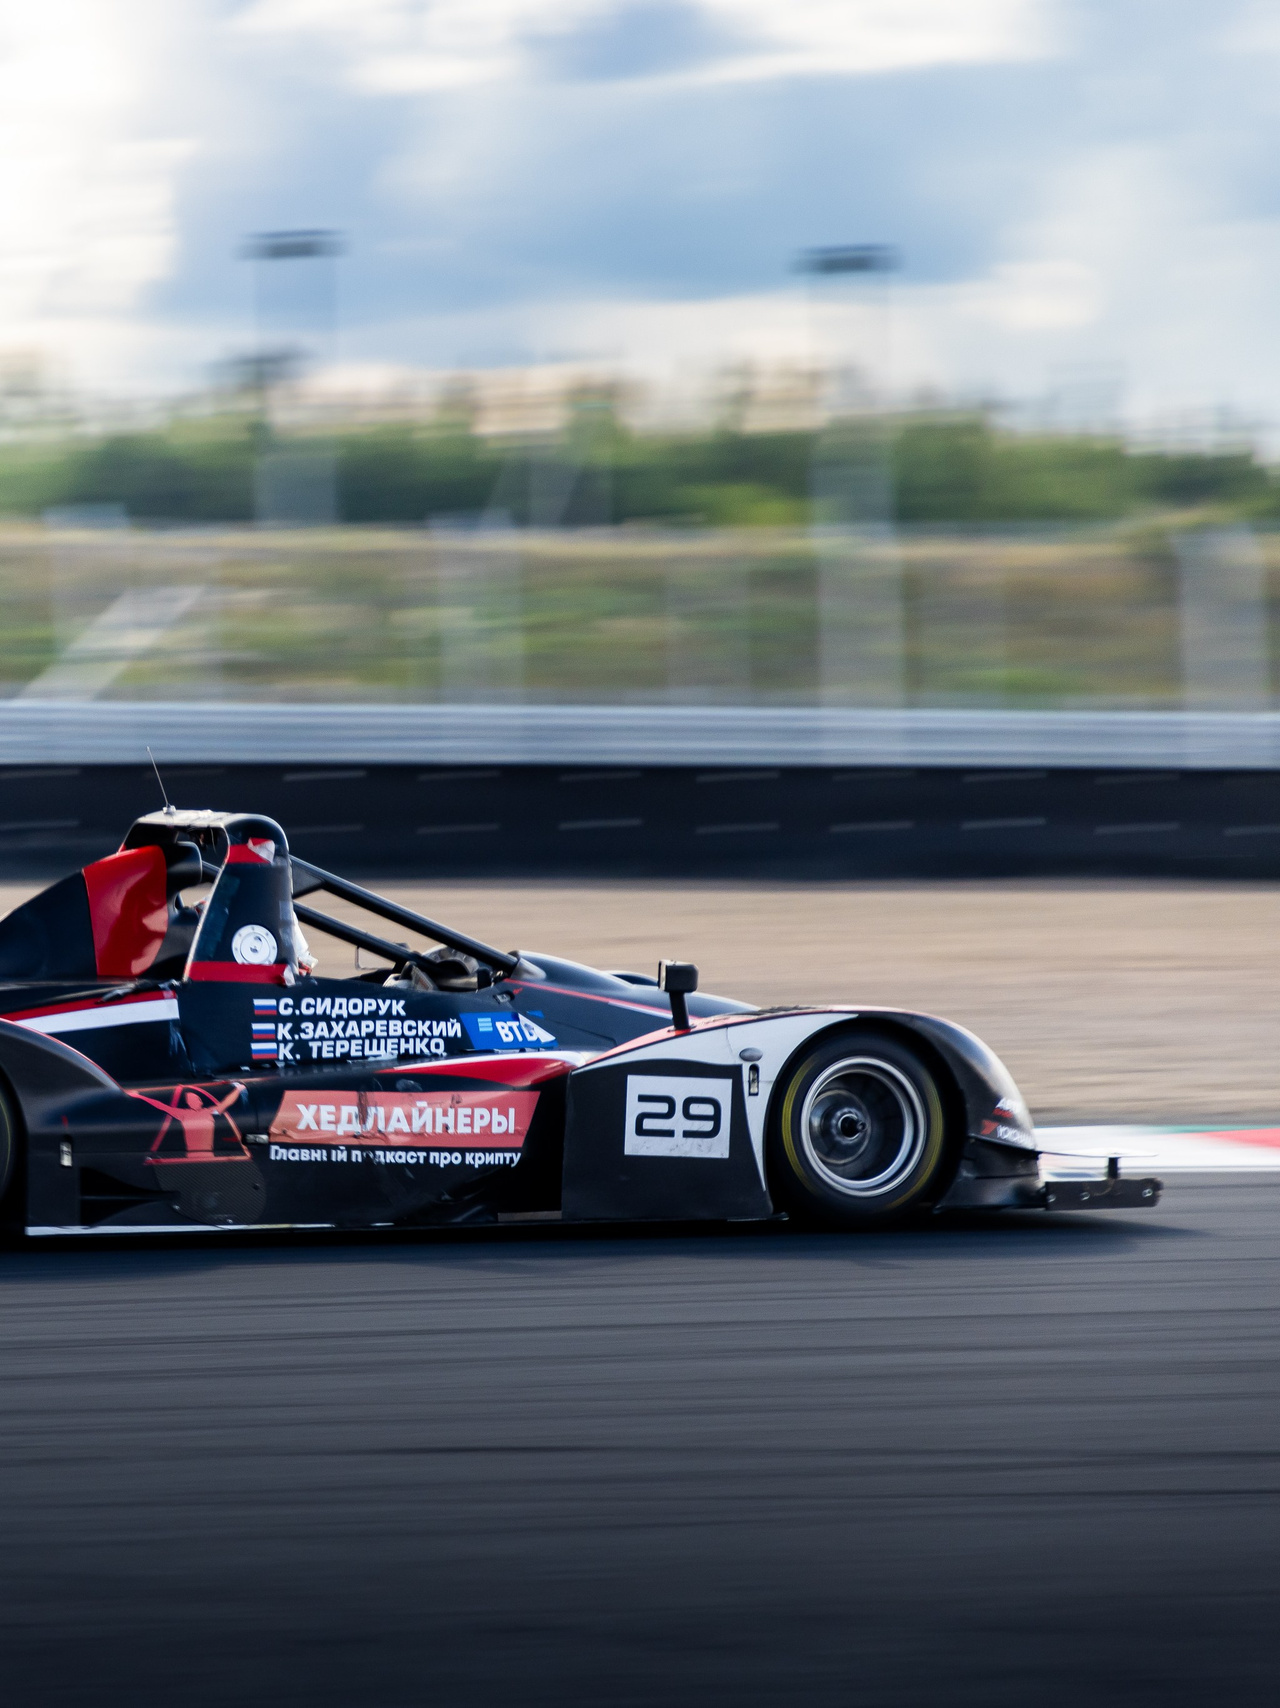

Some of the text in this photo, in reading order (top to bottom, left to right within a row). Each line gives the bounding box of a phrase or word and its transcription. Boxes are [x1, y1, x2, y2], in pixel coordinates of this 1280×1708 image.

[278, 997, 406, 1018] С.СИДОРУК
[277, 1018, 461, 1040] К.ЗАХАРЕВСКИЙ
[278, 1037, 446, 1060] К. ТЕРЕЩЕНКО
[295, 1101, 515, 1135] ХЕДЛАЙНЕРЫ
[635, 1094, 721, 1139] 29
[429, 1151, 462, 1168] про
[465, 1151, 521, 1168] крипту
